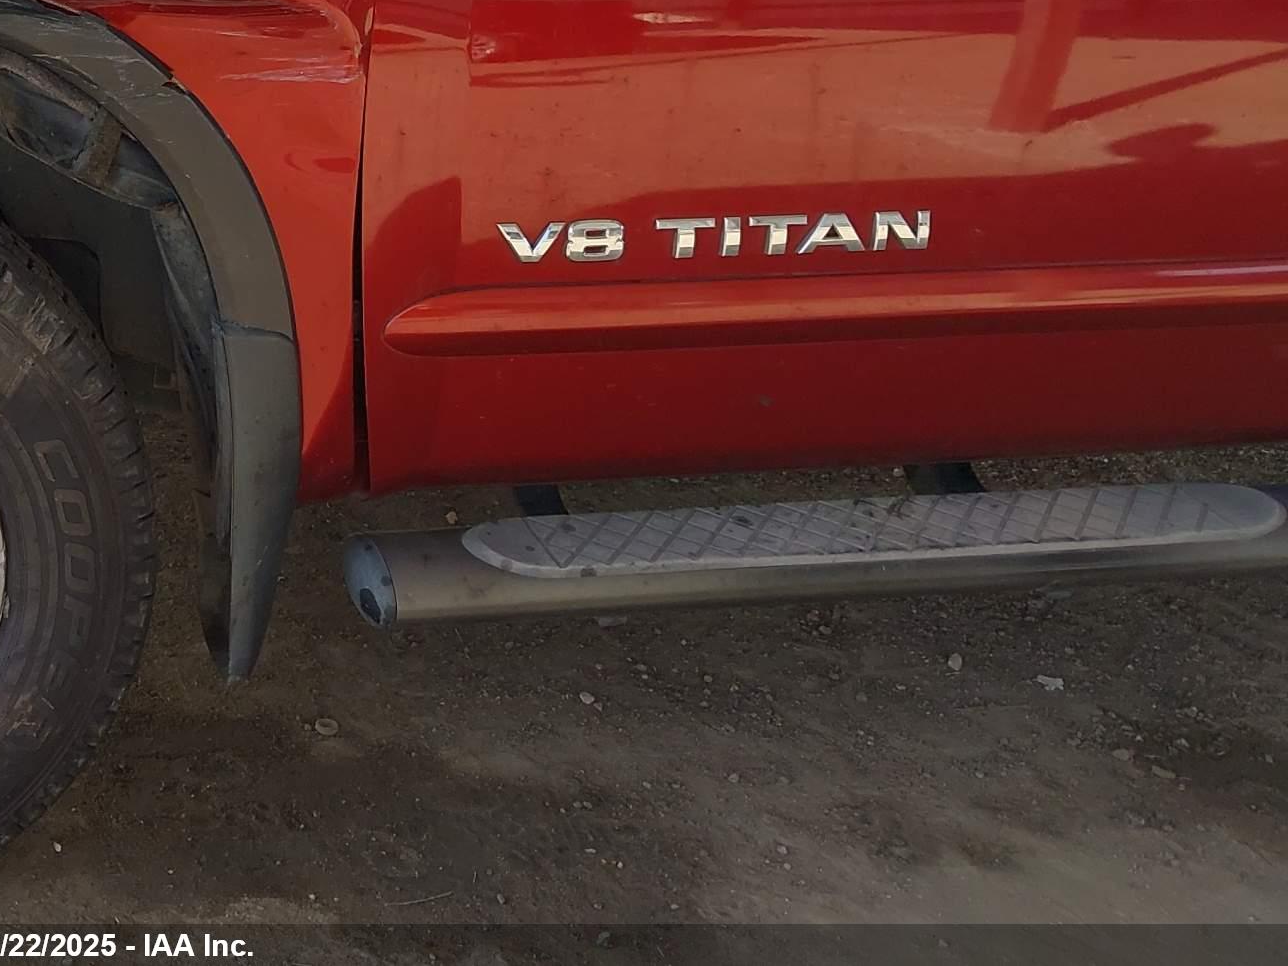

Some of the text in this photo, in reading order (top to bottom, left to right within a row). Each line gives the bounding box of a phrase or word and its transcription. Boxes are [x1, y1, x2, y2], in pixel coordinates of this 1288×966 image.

[496, 209, 931, 262] V8 TITAN
[22, 438, 97, 724] COOPE
